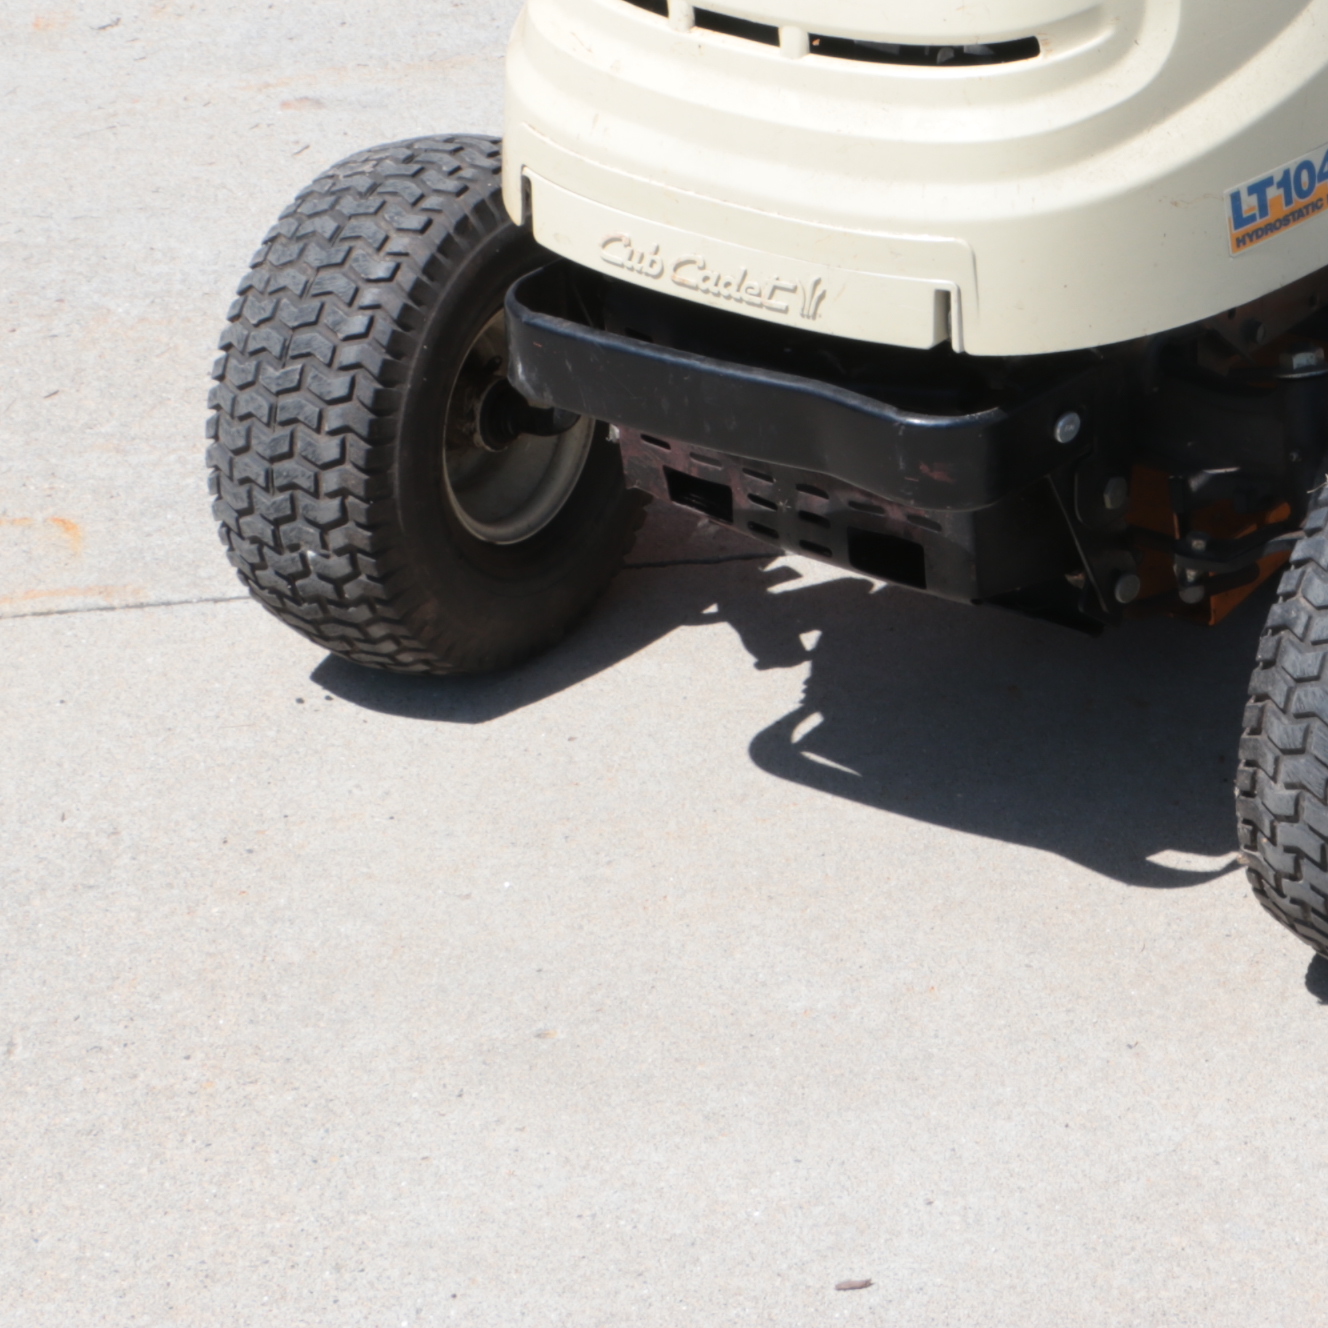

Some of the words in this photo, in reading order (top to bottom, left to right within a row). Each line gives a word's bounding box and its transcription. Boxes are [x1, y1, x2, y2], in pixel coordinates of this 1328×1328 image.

[1236, 197, 1324, 249] HYDROSTATIC
[600, 232, 664, 280] Cub
[671, 253, 798, 315] Cadet
